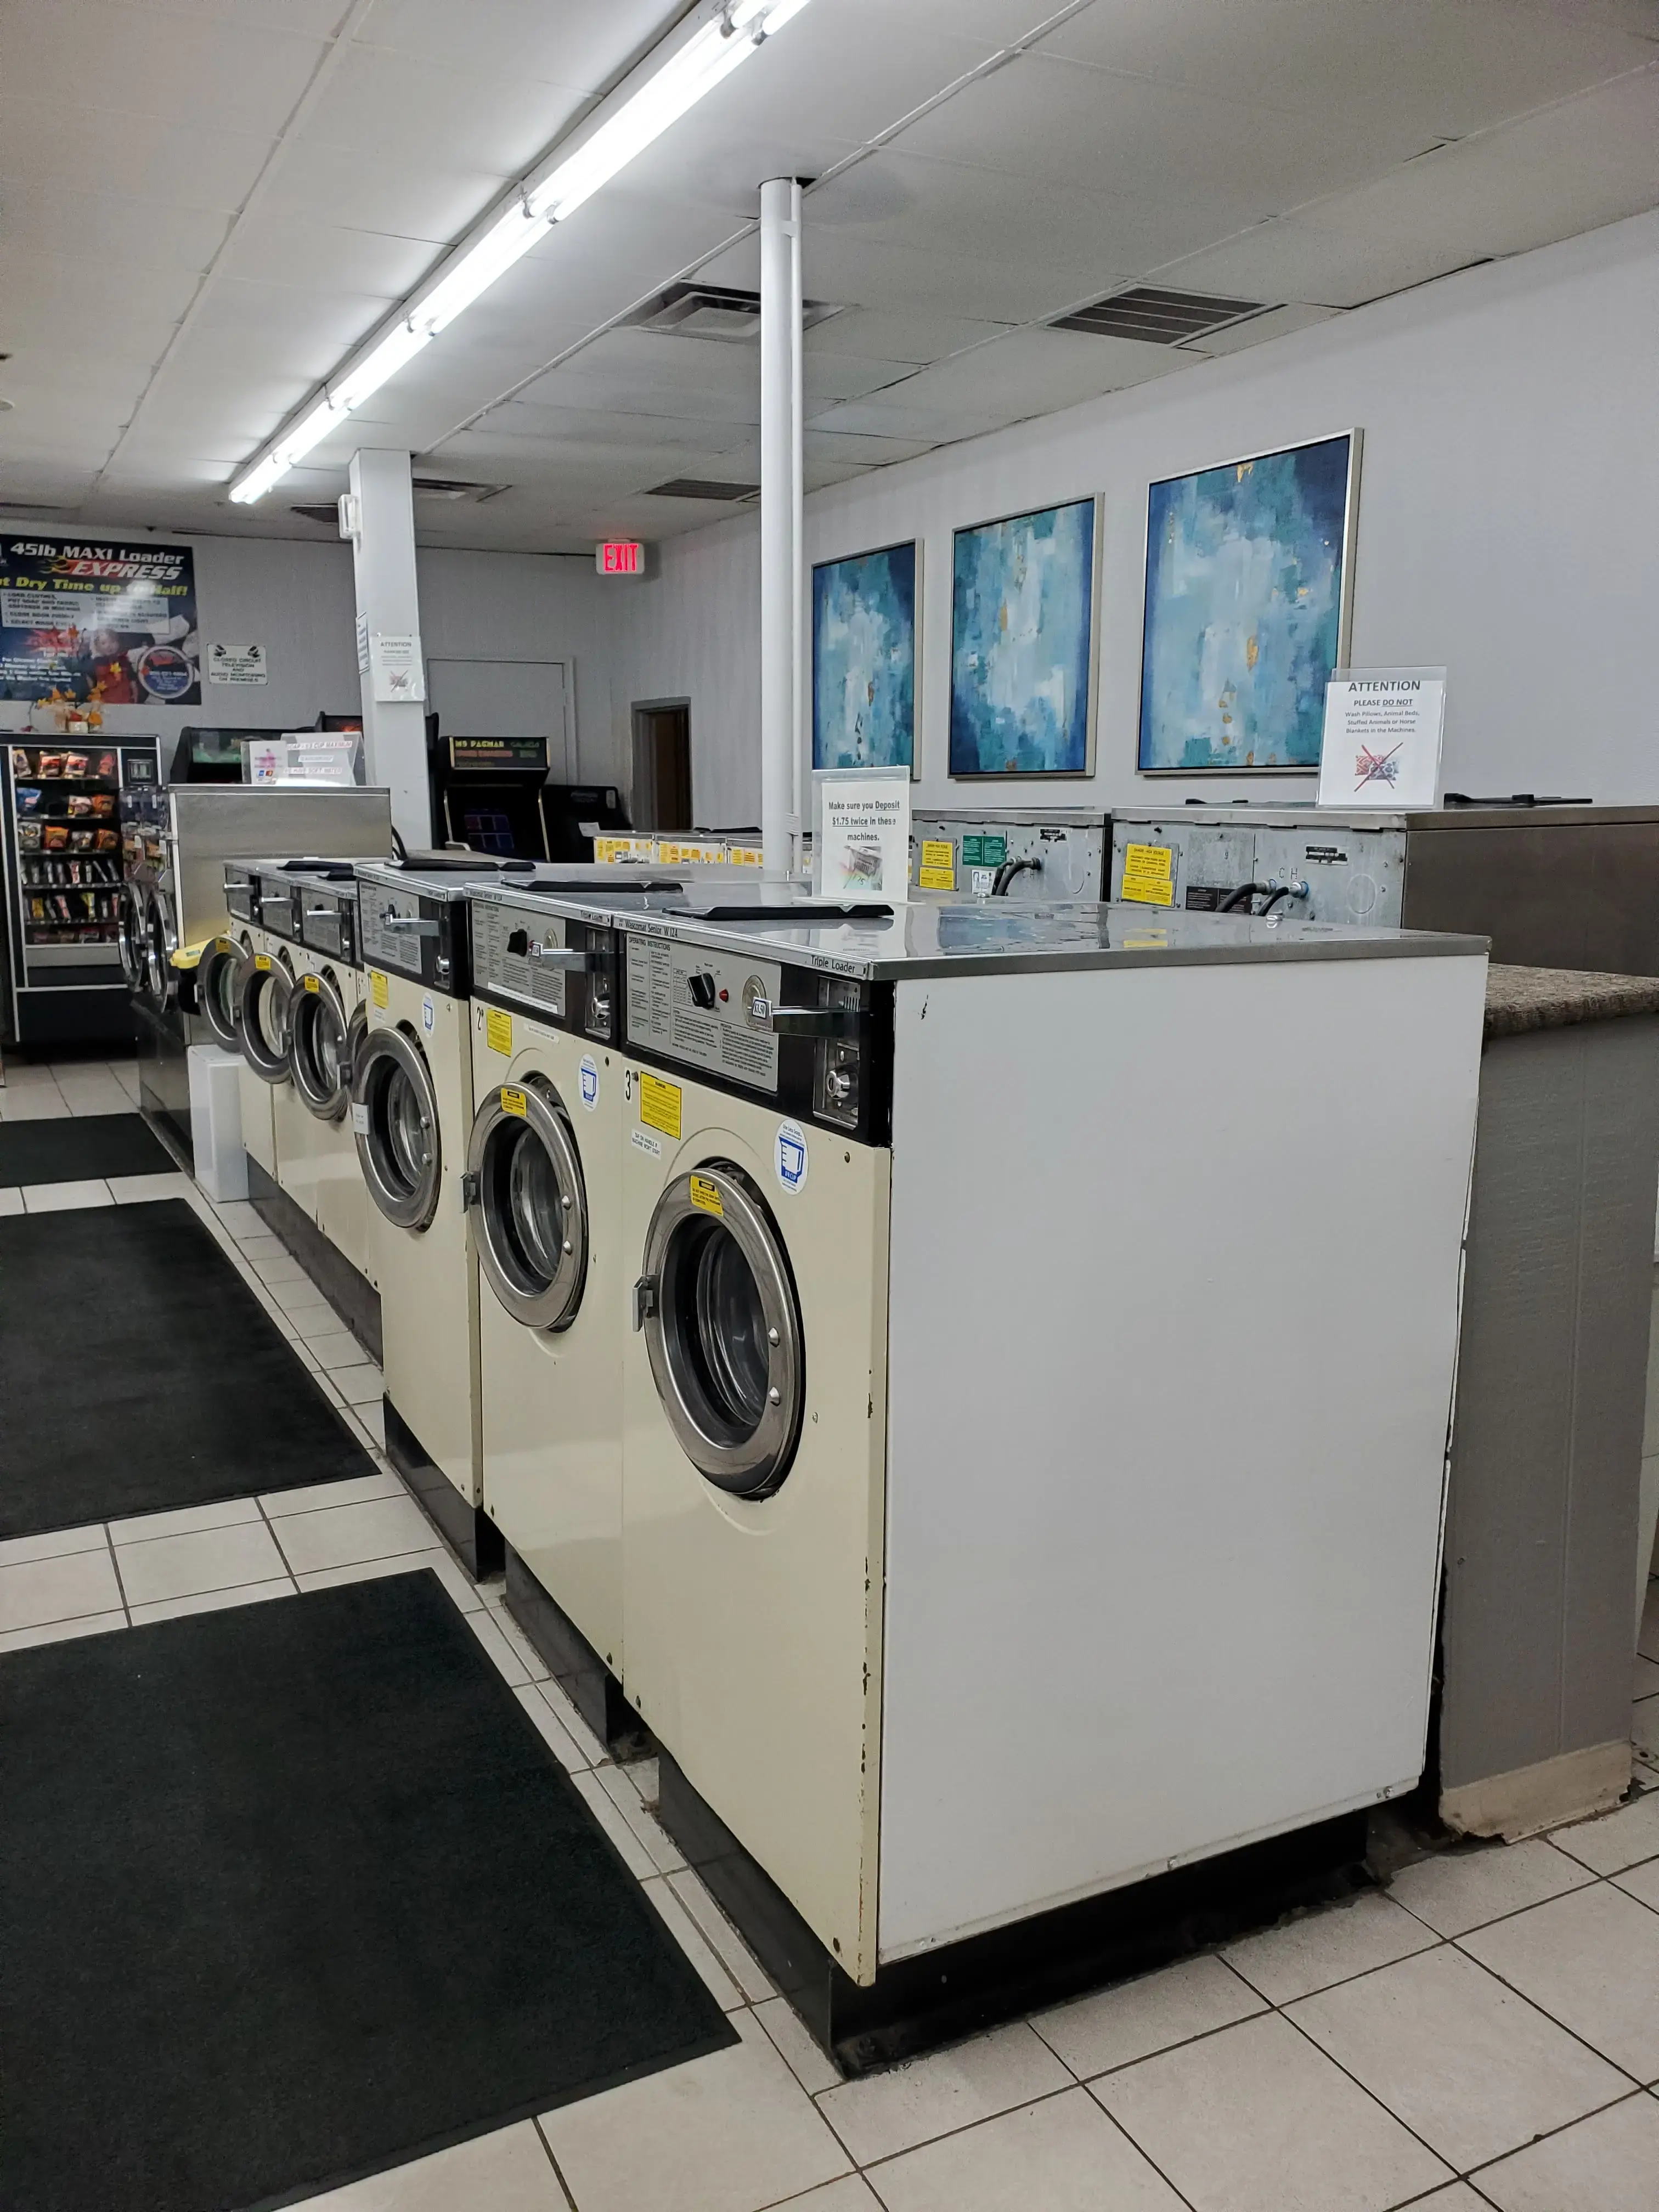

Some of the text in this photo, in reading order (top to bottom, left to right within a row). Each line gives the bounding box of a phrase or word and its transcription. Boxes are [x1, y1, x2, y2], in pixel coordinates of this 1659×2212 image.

[10, 542, 185, 565] 45lb MAXI Loader
[603, 544, 639, 572] EXIT
[71, 561, 183, 580] EXPRESS
[16, 577, 48, 591] Dry
[53, 579, 94, 591] Time
[100, 584, 121, 595] up
[1348, 680, 1421, 692] ATTENTION
[828, 801, 845, 810] Make
[862, 803, 873, 811] you
[875, 800, 900, 810] Deposit
[832, 816, 896, 826] $1.75 twice in these
[847, 832, 880, 841] machines.
[1279, 867, 1298, 879] C H
[625, 920, 646, 932] Wascomat
[648, 923, 662, 934] Senior
[811, 955, 856, 974] Triple Loader
[477, 1006, 481, 1031] 2
[625, 1070, 631, 1101] 3
